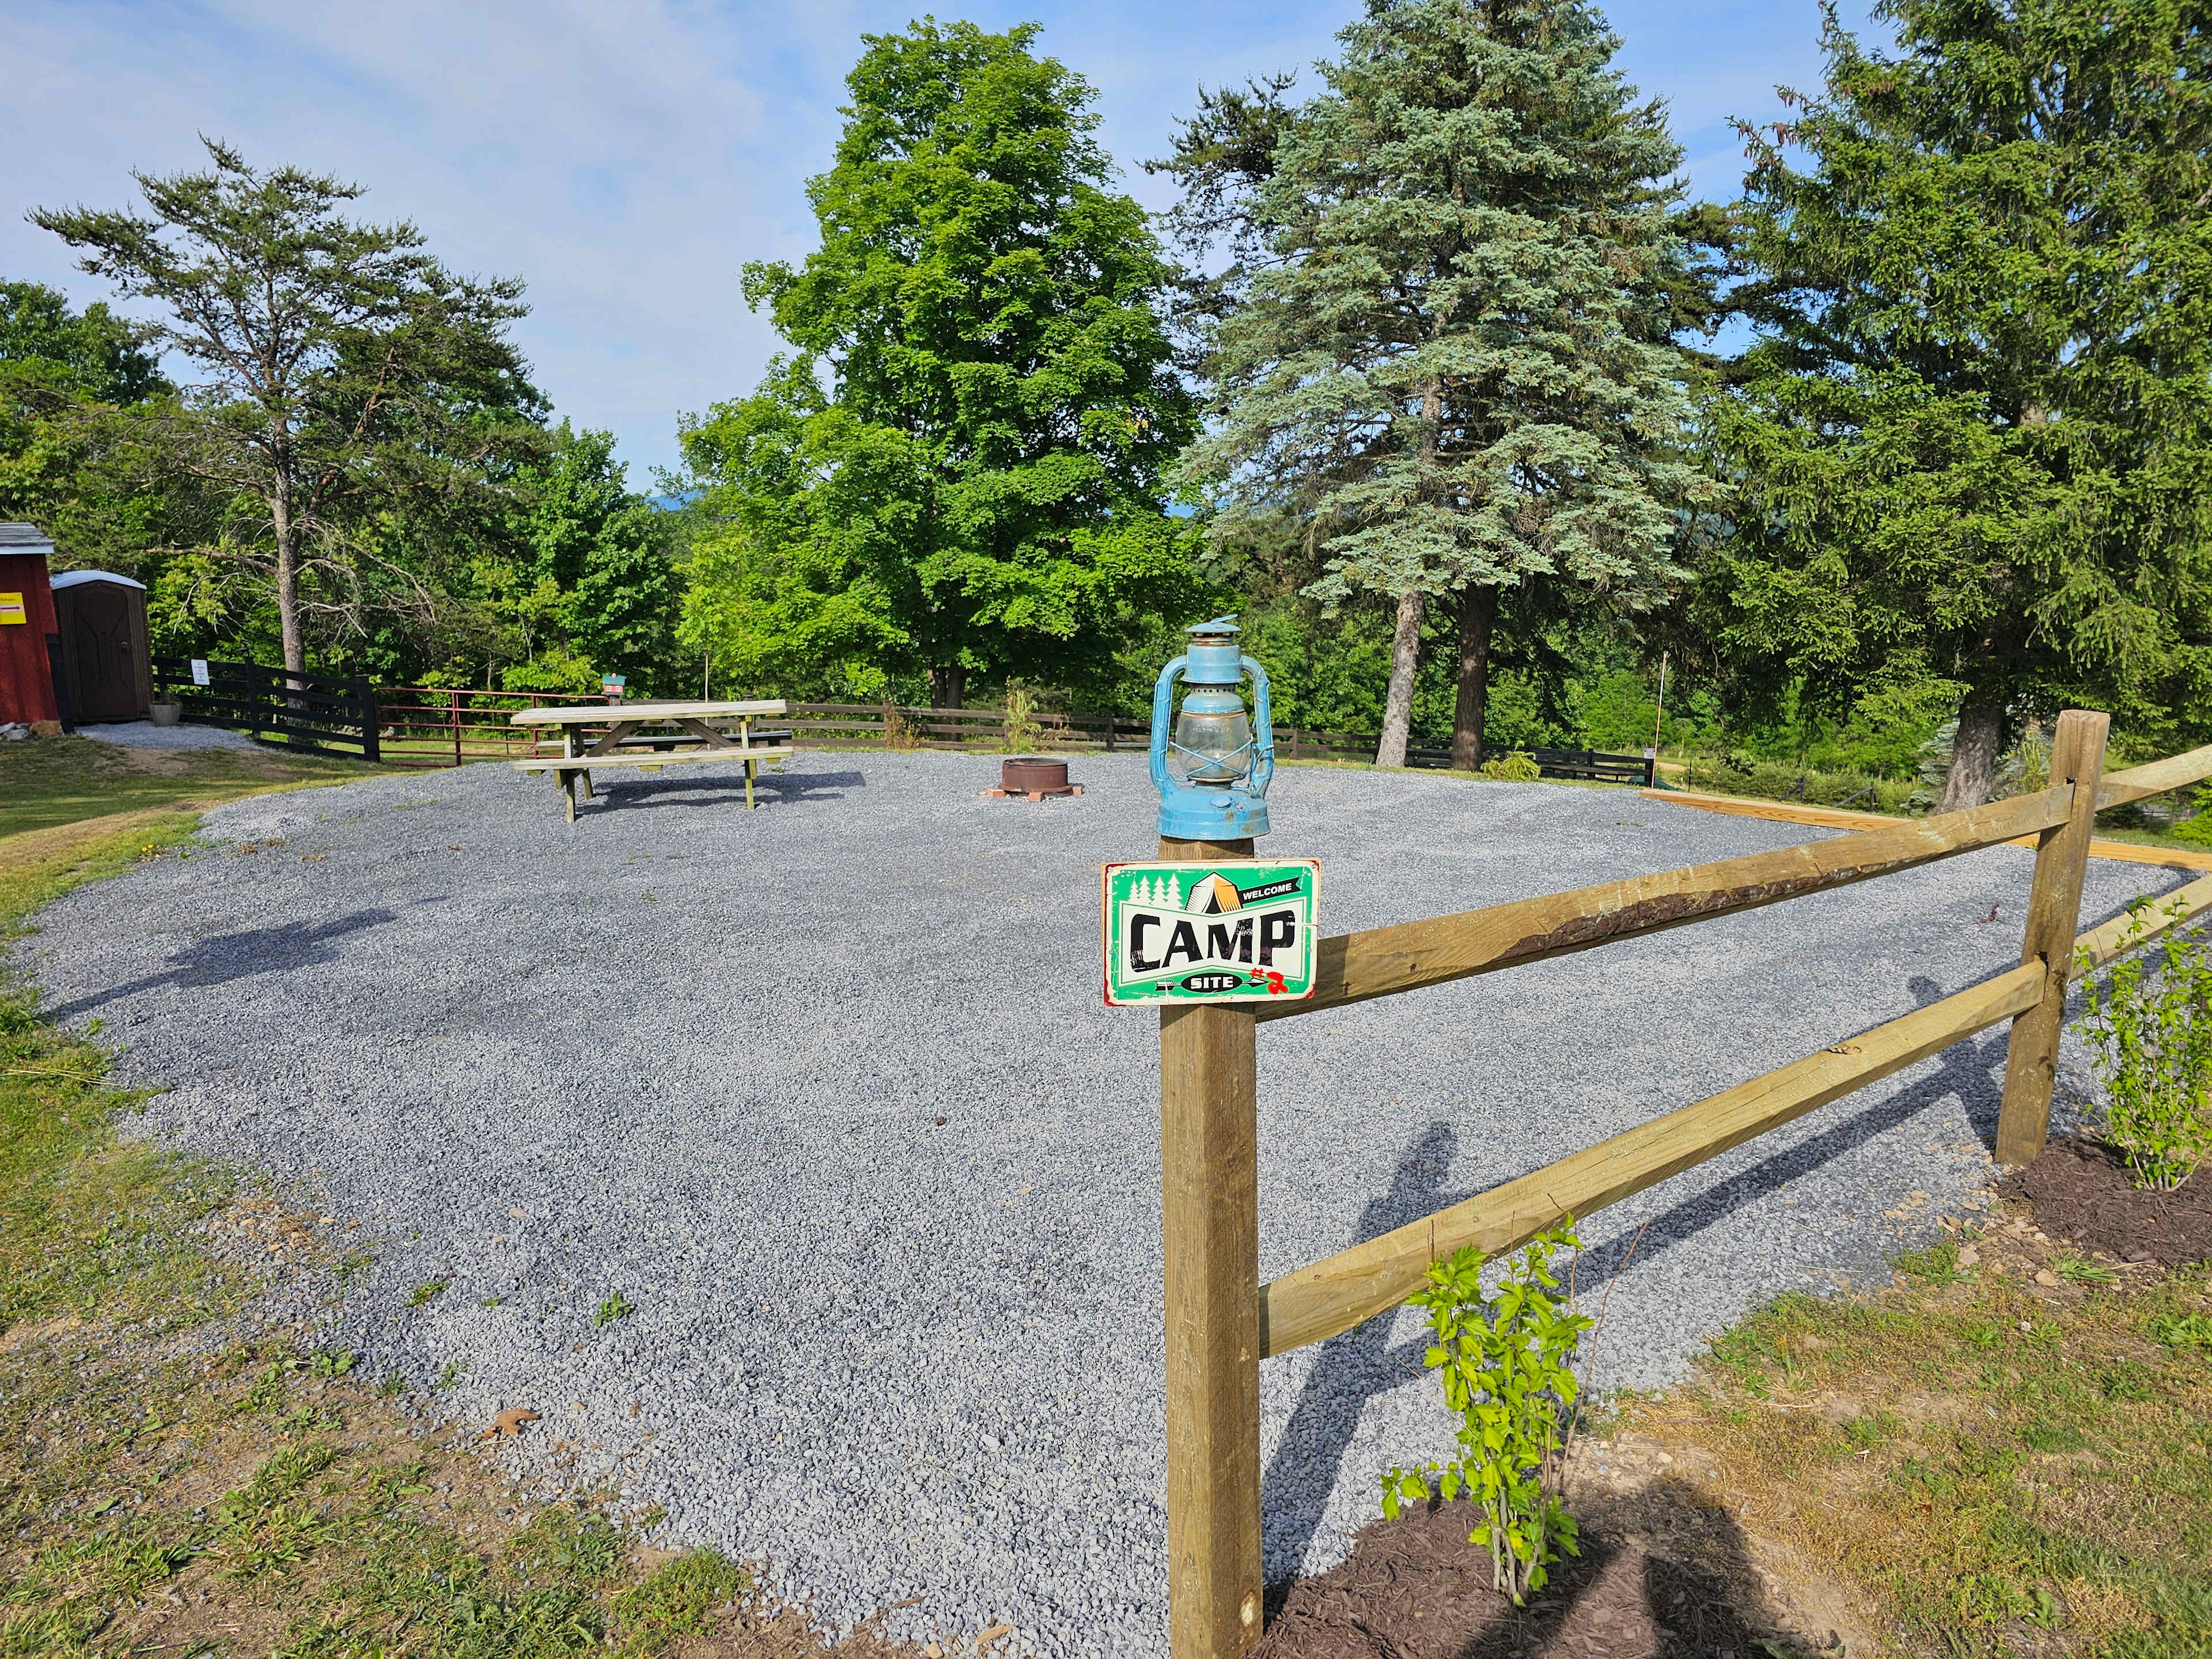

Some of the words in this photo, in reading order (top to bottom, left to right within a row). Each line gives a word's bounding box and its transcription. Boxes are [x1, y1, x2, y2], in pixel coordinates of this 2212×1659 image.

[1243, 883, 1292, 900] WELCOME
[1130, 910, 1296, 973] CAMP
[1191, 976, 1233, 989] SITE
